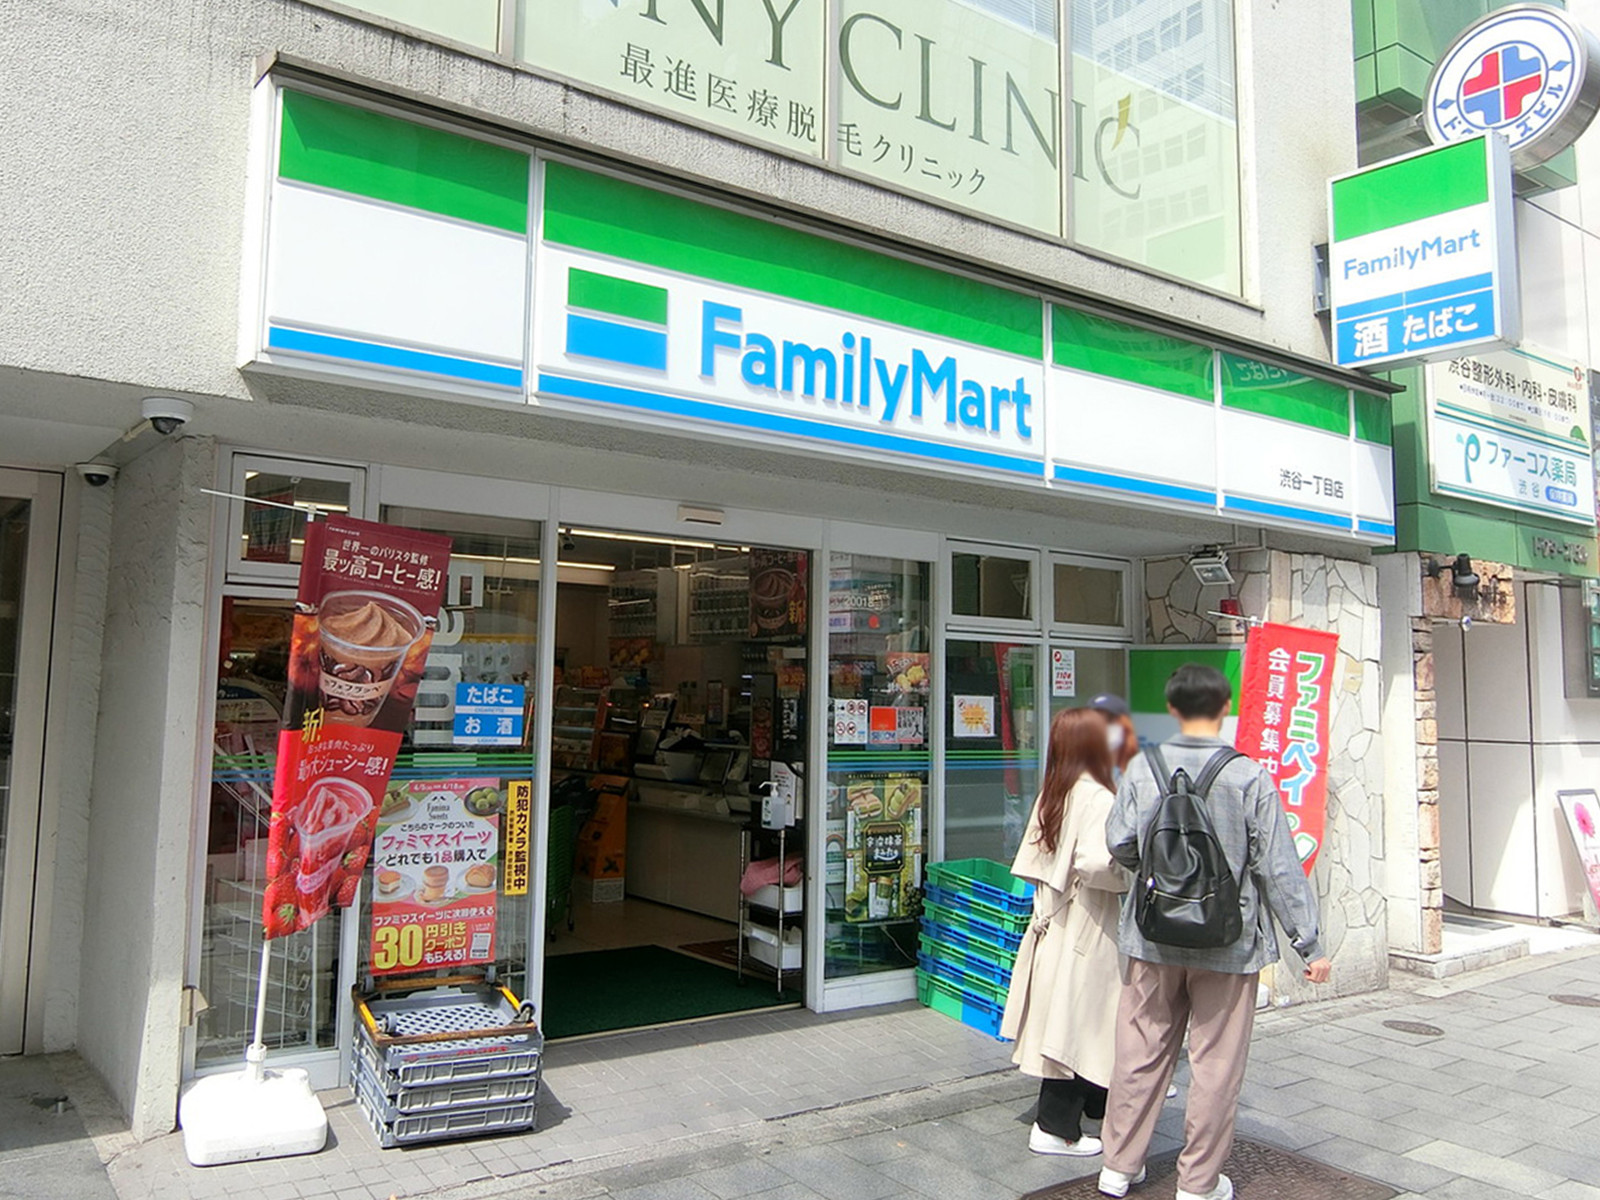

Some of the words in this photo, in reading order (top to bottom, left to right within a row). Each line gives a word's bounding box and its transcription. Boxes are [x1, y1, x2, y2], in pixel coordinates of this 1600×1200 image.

[619, 42, 987, 196] 最進医療脱毛クリニック
[838, 12, 1141, 200] CLINIC
[1344, 228, 1481, 280] FamilyMart
[1353, 316, 1389, 358] 酒
[1402, 303, 1479, 346] たばこ
[701, 300, 1032, 440] FamilyMart
[1280, 467, 1345, 500] 渋谷一丁目店
[1486, 440, 1577, 488] ファーコス薬局
[322, 547, 442, 592] 最ッ高コーヒー感!
[342, 538, 429, 567] 世界一のバリスタ監修
[466, 685, 514, 704] たばこ
[1258, 647, 1292, 776] 会員募集中
[1280, 651, 1326, 806] ファミペイ
[382, 830, 492, 850] ファミマスイーツ
[400, 821, 475, 832] こちらのマークのついた
[513, 785, 529, 890] 防犯カメラ監視中
[385, 848, 487, 867] どれでも1品購入で
[375, 923, 423, 970] 30
[425, 921, 467, 938] 円引き
[424, 936, 466, 952] クーポン
[424, 948, 467, 965] もらえる!
